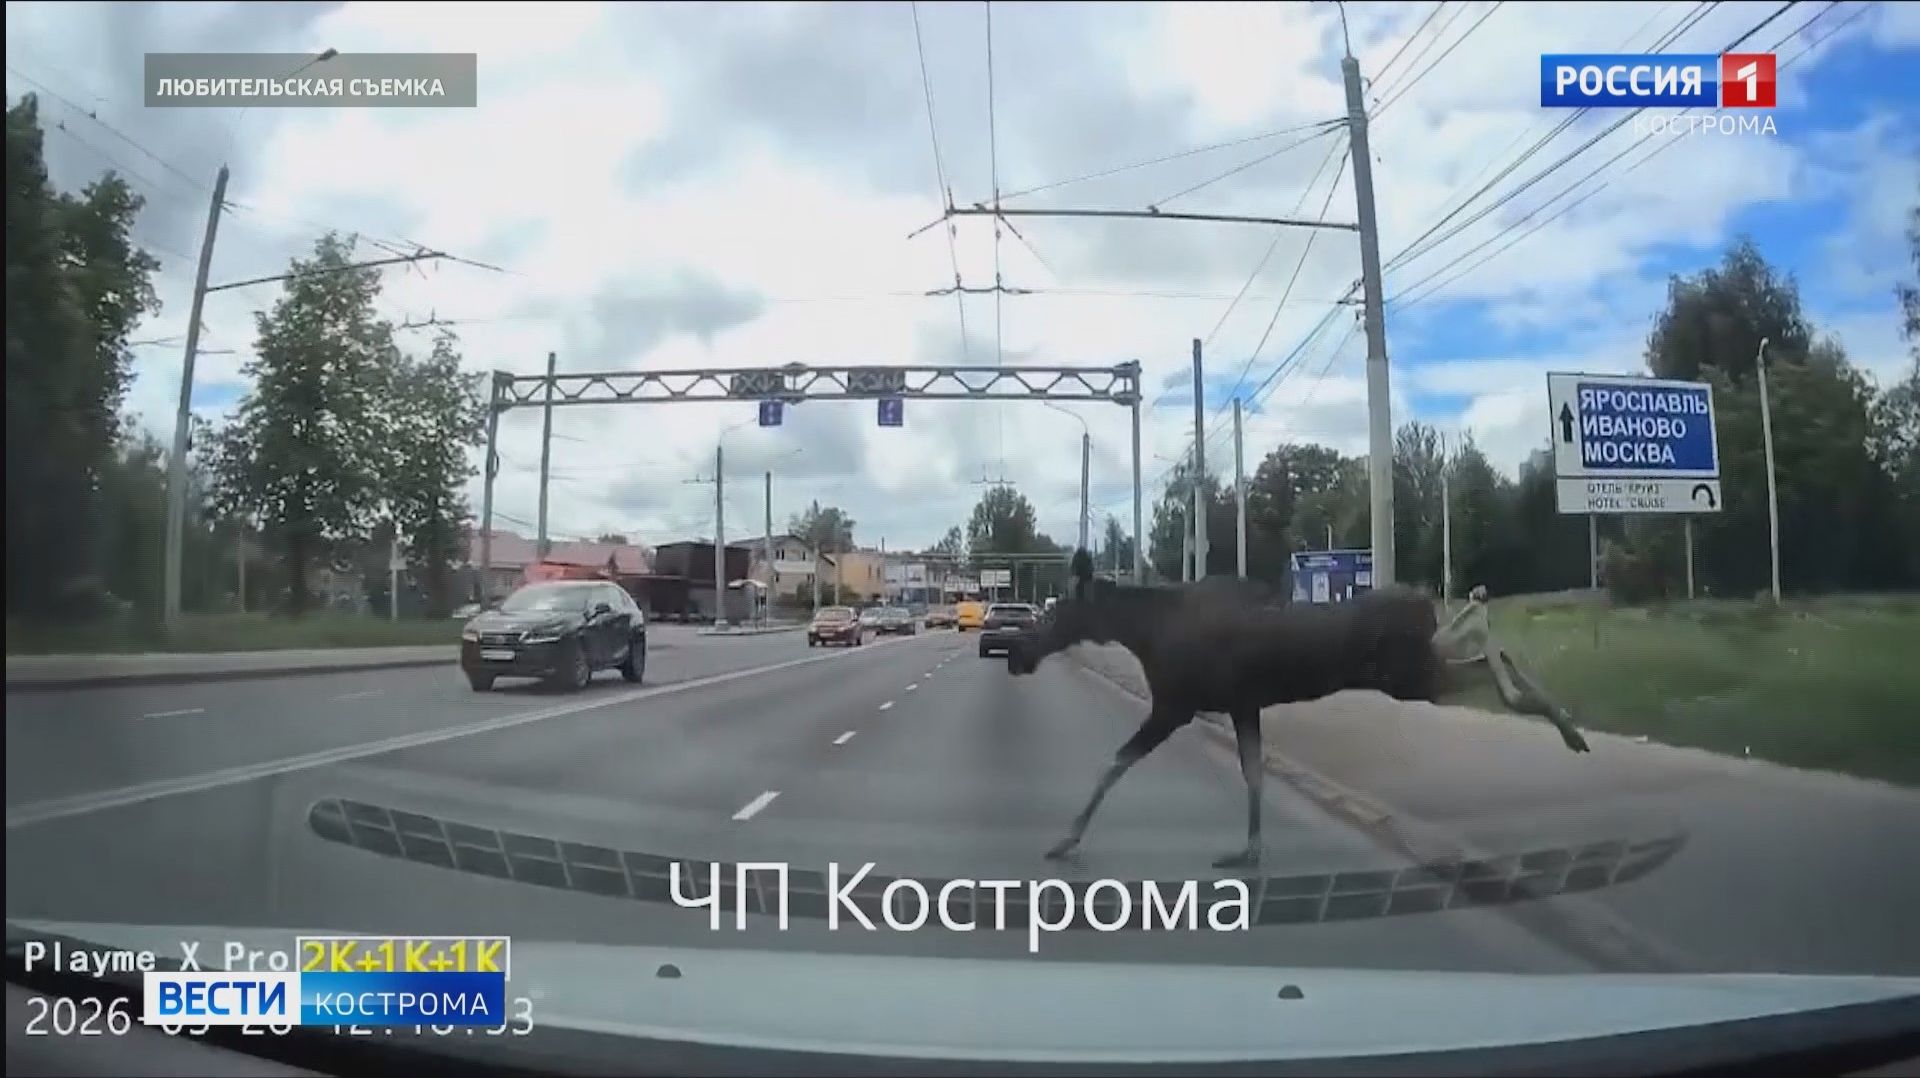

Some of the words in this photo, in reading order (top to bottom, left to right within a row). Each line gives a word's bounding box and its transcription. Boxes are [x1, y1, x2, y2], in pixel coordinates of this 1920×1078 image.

[1580, 389, 1708, 414] ЯРОСЛАВЛЬ
[1582, 415, 1686, 438] ИВАНОВО
[1585, 441, 1676, 464] МОСКВА
